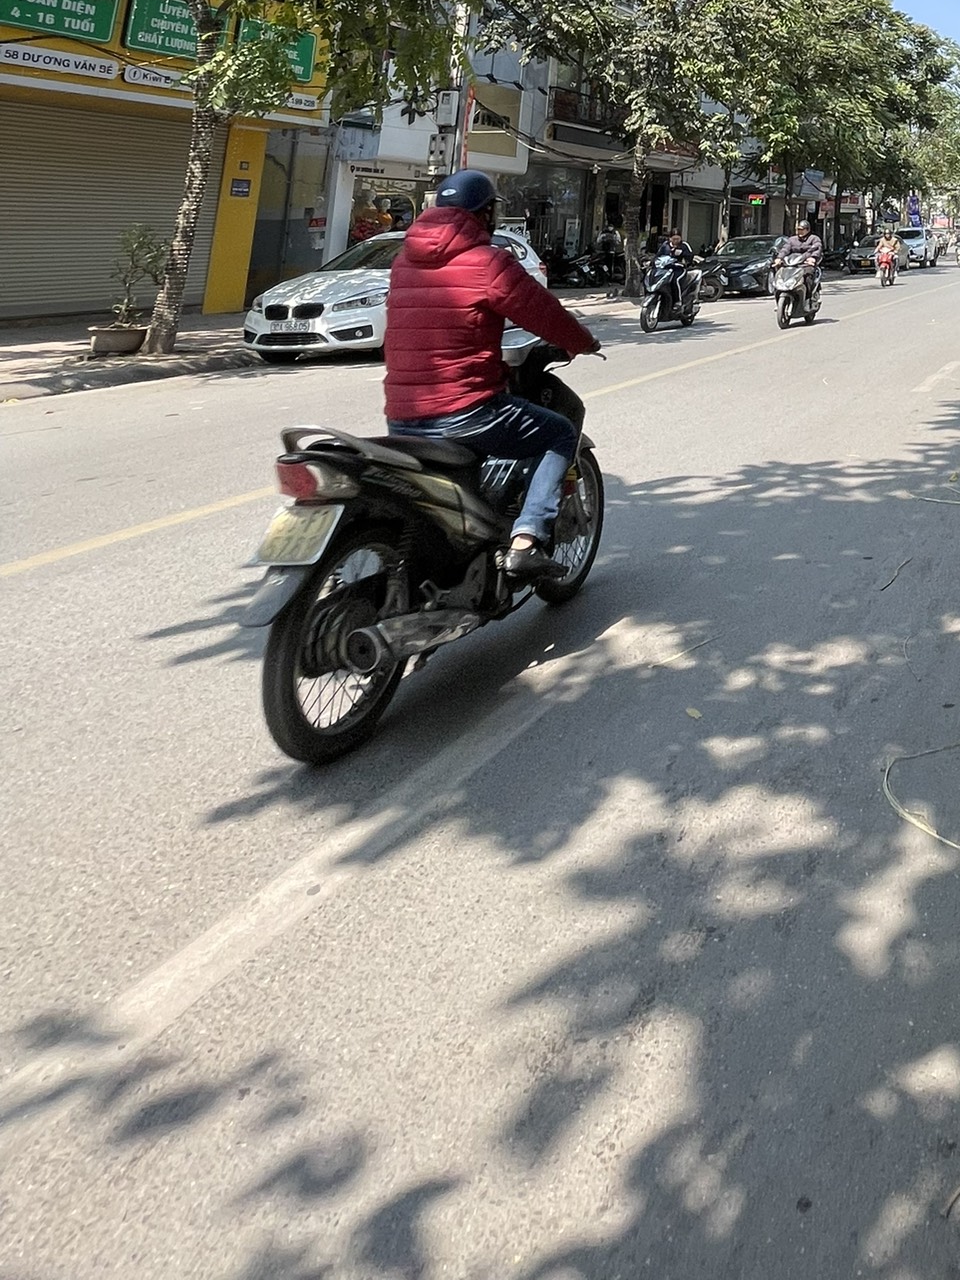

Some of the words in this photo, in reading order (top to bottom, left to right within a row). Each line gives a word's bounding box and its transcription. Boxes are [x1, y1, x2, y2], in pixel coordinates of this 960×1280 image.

[10, 6, 21, 18] 4
[37, 12, 55, 25] 16
[61, 0, 96, 16] DIỆN
[4, 49, 19, 60] 58
[22, 52, 71, 69] DƯƠNG
[74, 59, 97, 72] VĂN
